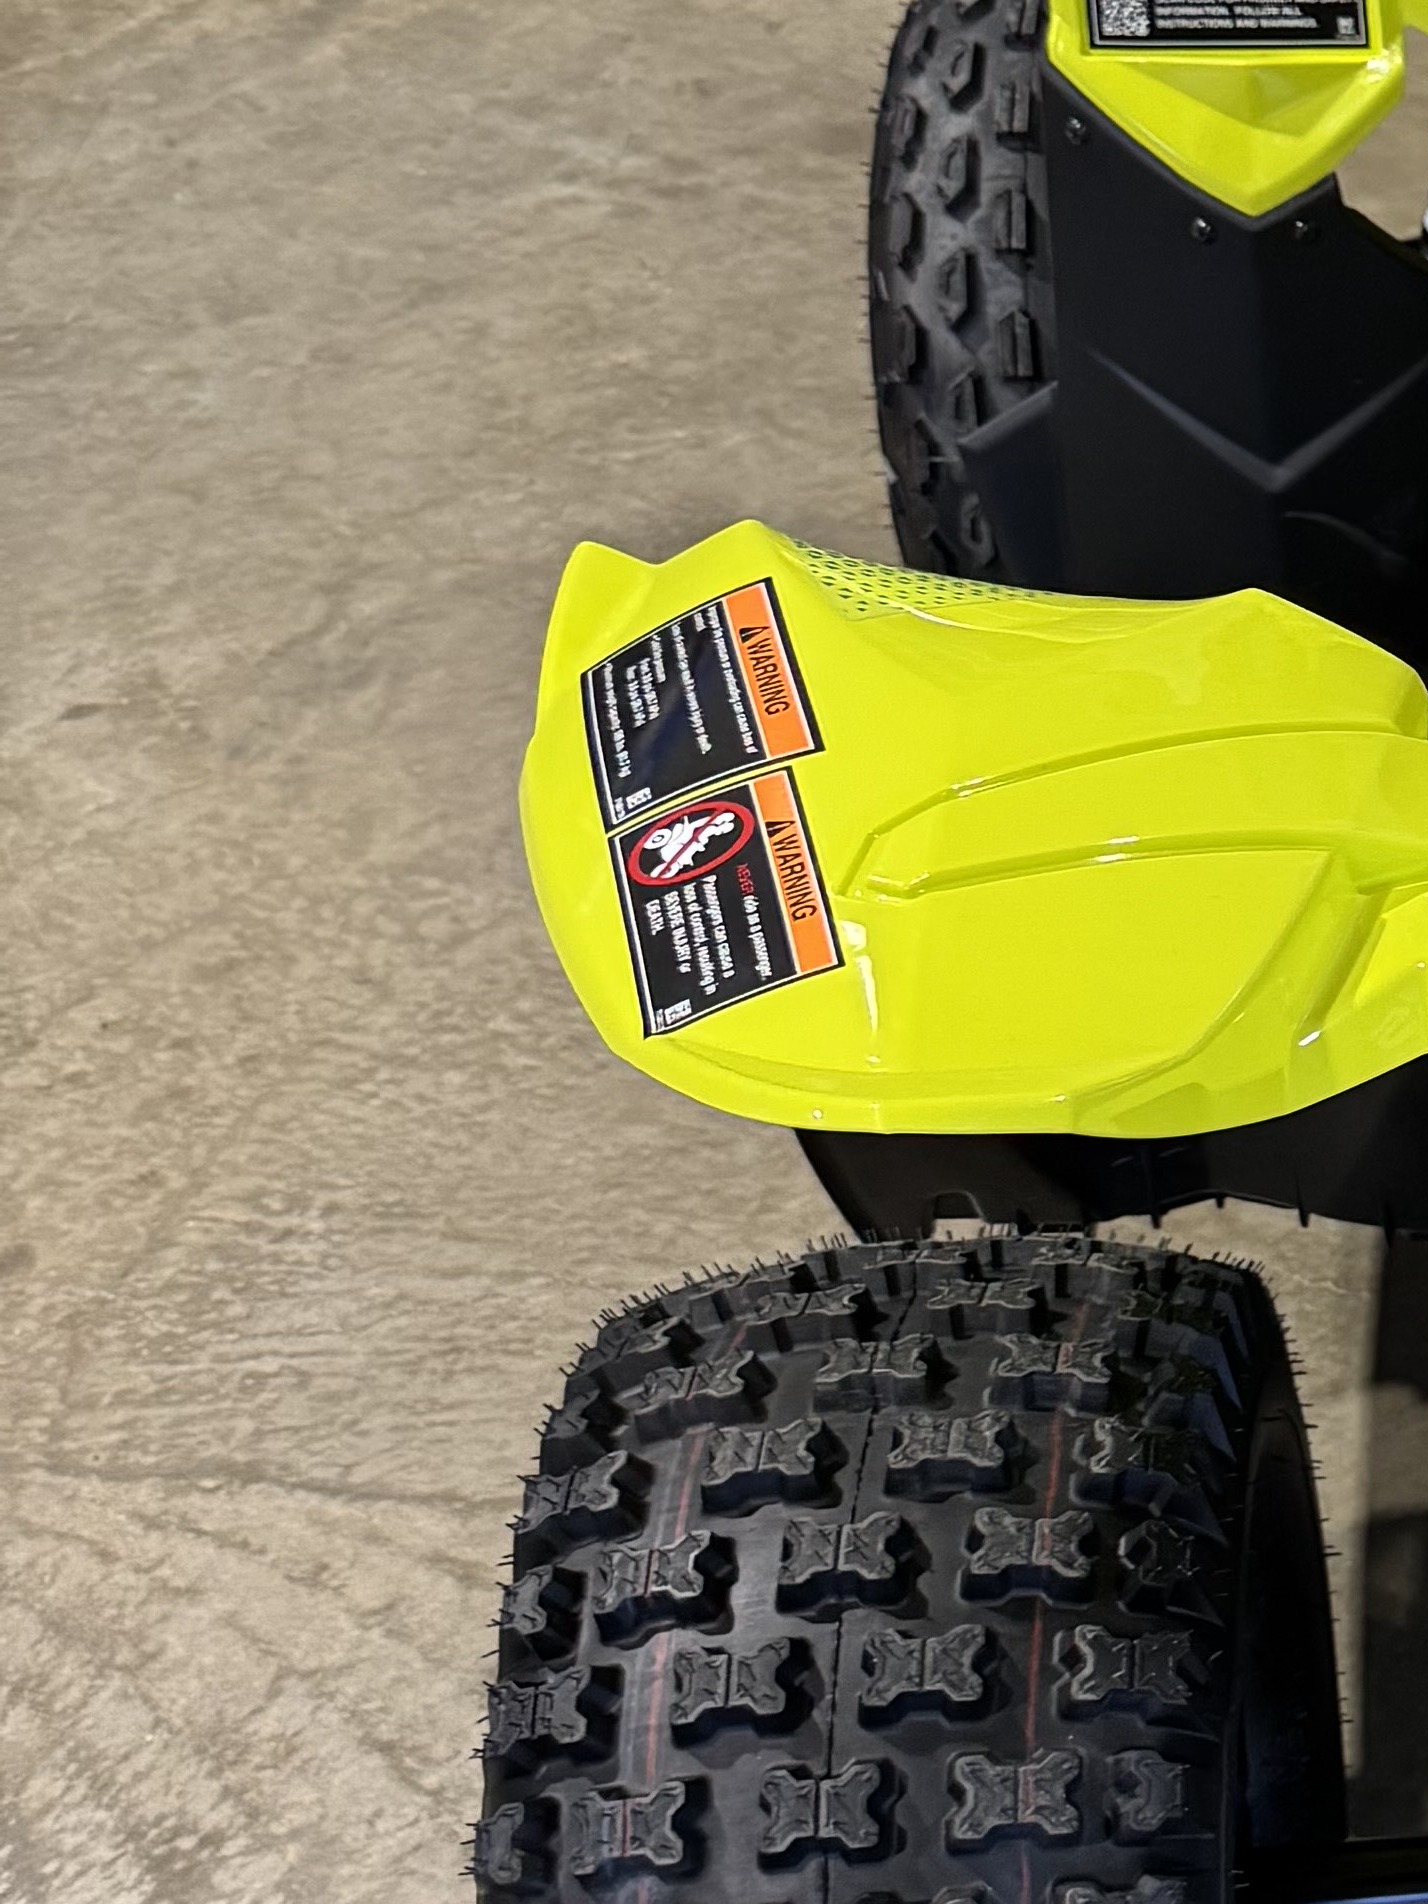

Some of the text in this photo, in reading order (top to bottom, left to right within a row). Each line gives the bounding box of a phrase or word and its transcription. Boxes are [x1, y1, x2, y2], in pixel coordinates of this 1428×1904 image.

[746, 637, 791, 717] WARNING
[776, 833, 817, 923] WARNING
[663, 889, 684, 929] SEVERE
[699, 873, 726, 927] Passengers
[742, 892, 760, 914] ride
[671, 925, 691, 963] INJURY
[713, 924, 728, 943] can
[692, 944, 717, 986] resulting
[717, 941, 734, 971] cause
[748, 930, 773, 982] passenger.
